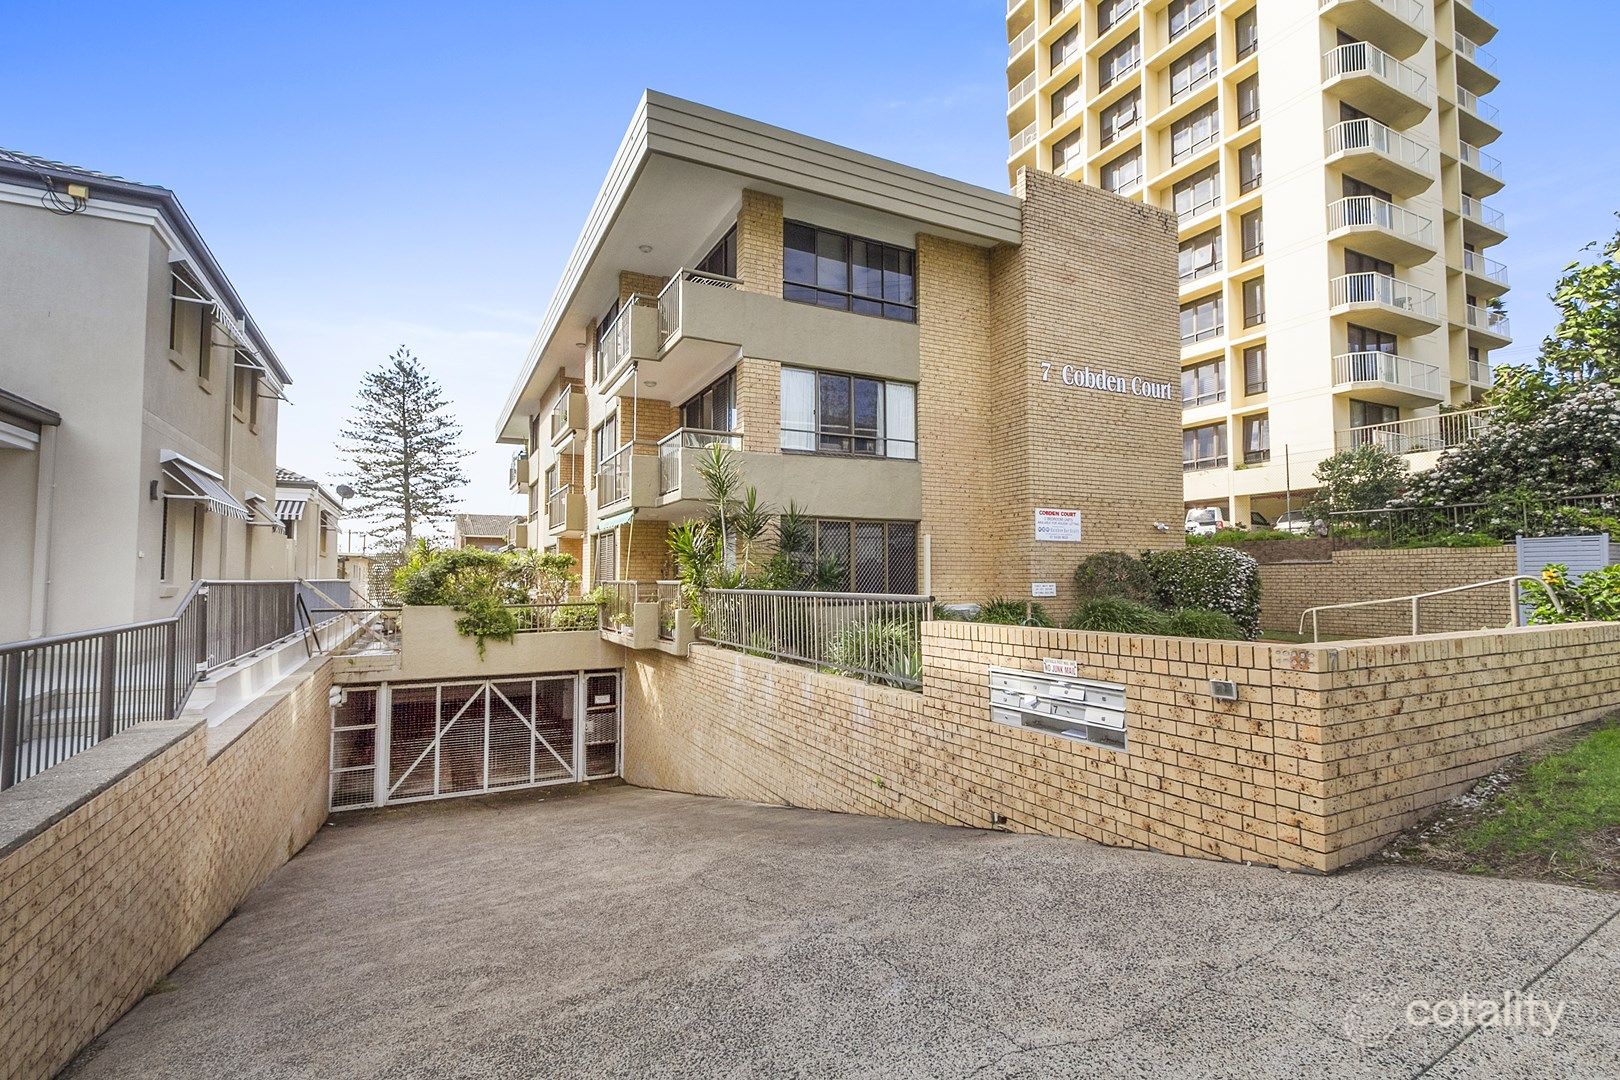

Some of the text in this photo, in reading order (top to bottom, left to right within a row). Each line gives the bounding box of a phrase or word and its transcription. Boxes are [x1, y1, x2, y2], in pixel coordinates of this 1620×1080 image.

[1040, 361, 1172, 400] 7 Cobden Court
[1045, 664, 1076, 675] NO JUNK MAIL
[1053, 705, 1058, 714] 7
